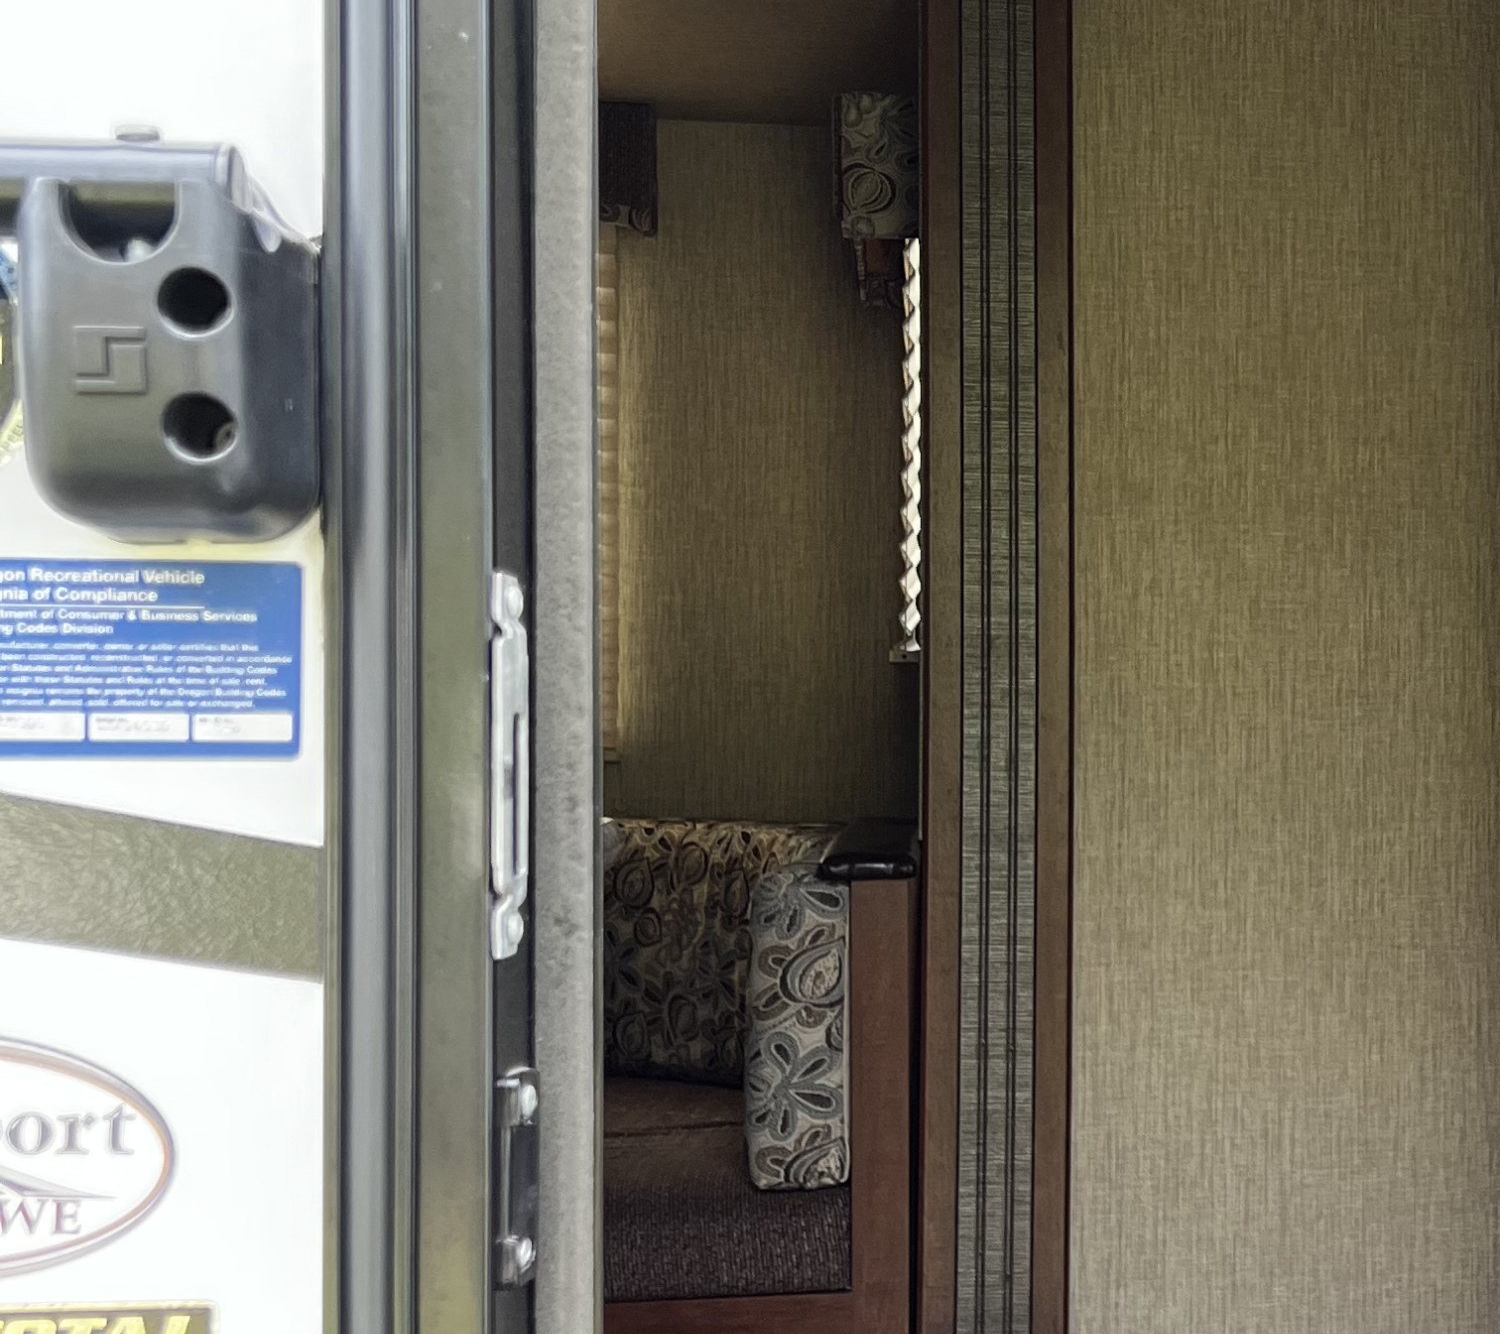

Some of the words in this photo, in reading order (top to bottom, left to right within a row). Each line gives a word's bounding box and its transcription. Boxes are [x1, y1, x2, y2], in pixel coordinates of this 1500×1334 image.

[0, 568, 25, 583] on
[30, 568, 140, 583] Recreational
[142, 570, 206, 585] Vehicle
[0, 587, 29, 602] nia
[33, 587, 51, 601] of
[55, 587, 159, 604] Compliance
[41, 609, 55, 620] of
[58, 609, 125, 621] Consumer
[127, 609, 137, 621] &
[141, 609, 199, 622] Business
[202, 610, 258, 623] Services
[17, 623, 59, 634] Codes
[61, 623, 114, 635] Division
[0, 1103, 136, 1156] ort
